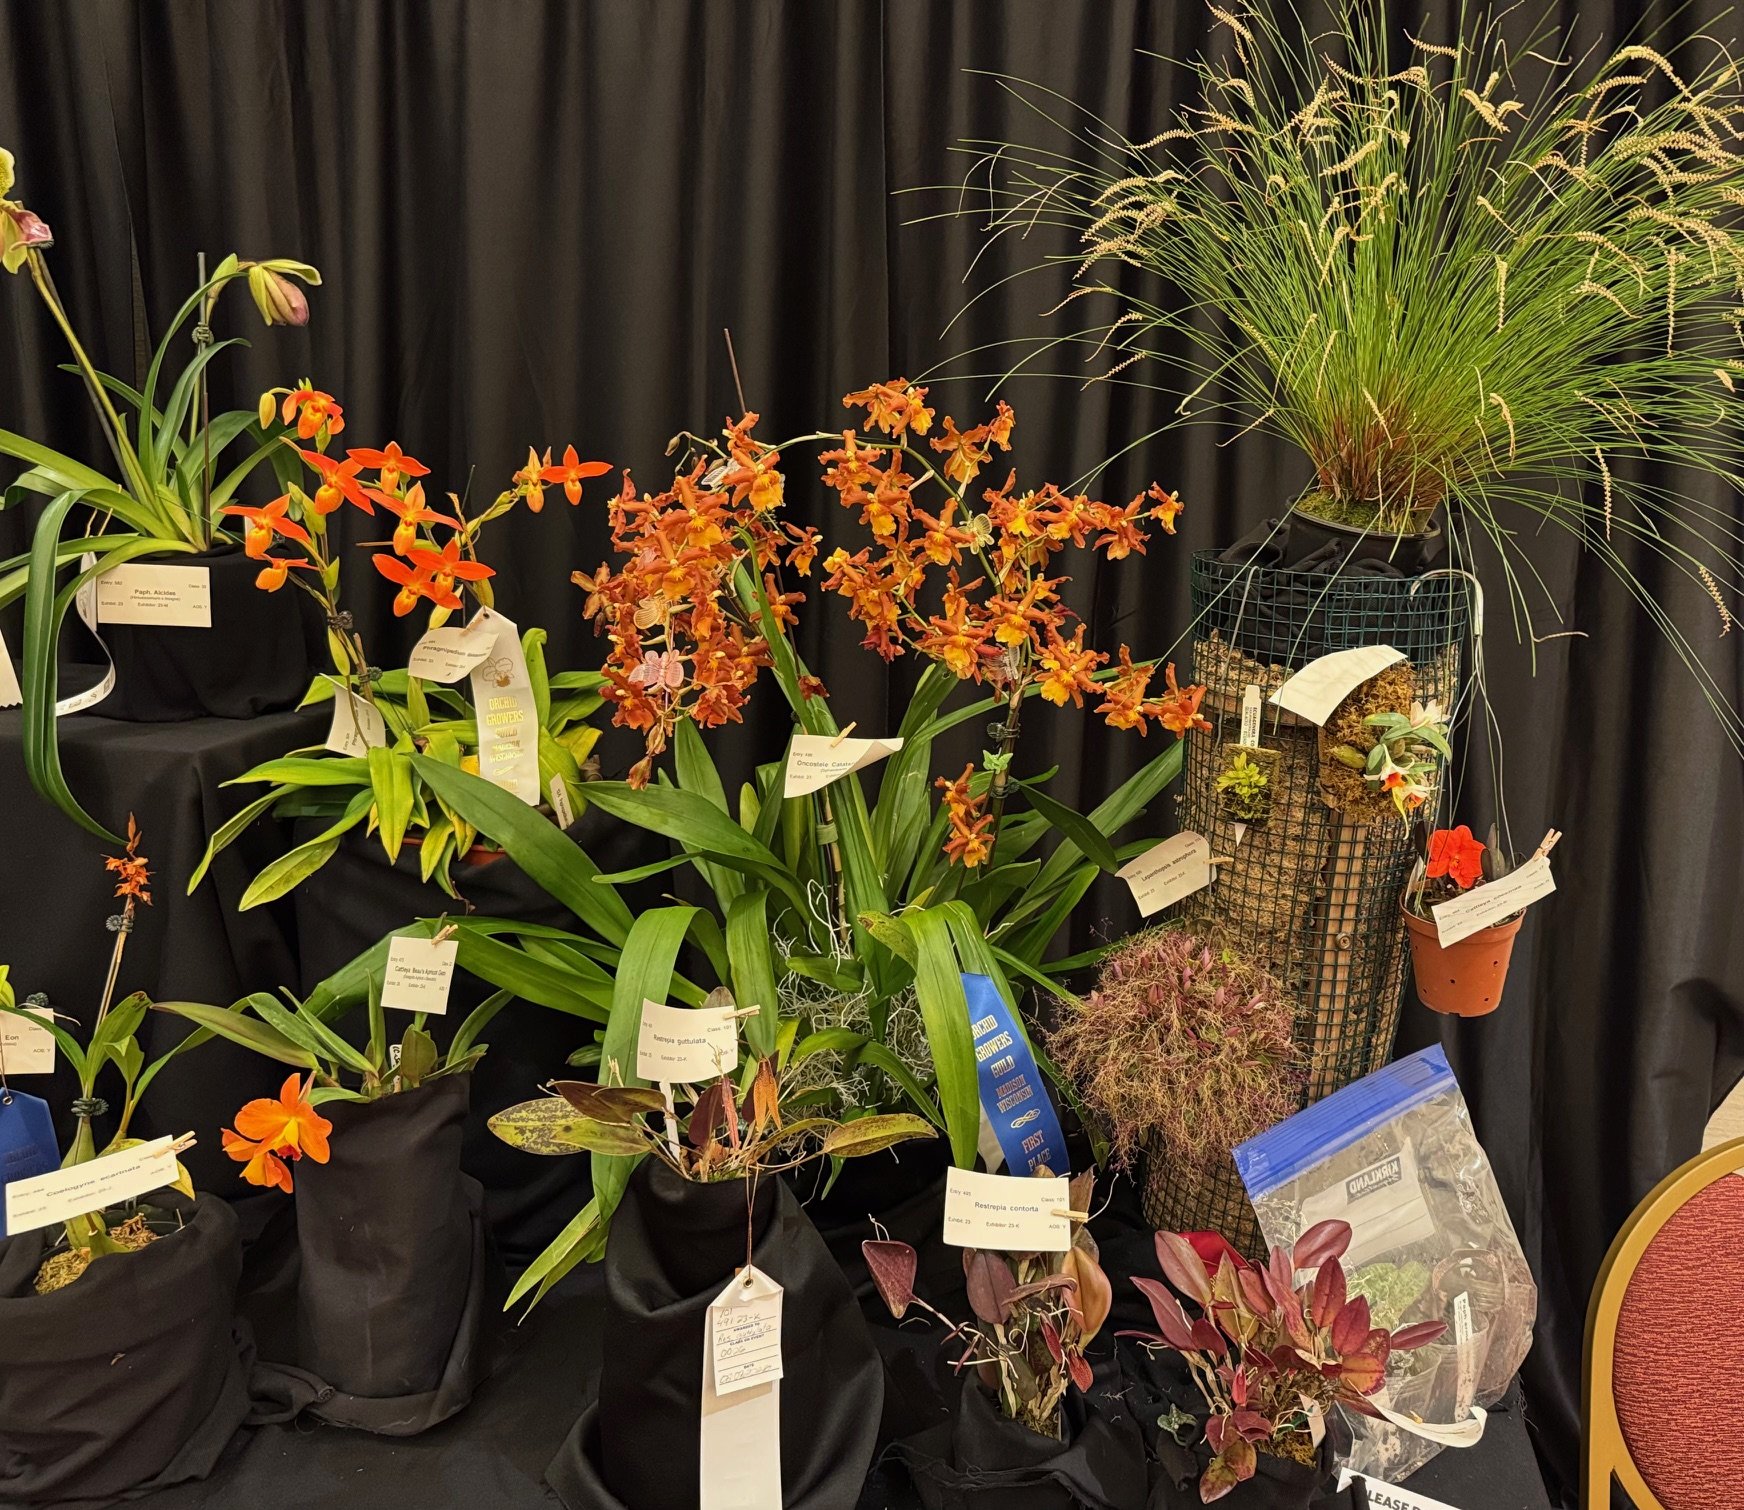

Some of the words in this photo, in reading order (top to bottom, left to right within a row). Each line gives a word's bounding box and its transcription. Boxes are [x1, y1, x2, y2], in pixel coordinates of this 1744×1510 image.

[489, 695, 518, 711] ORCHID
[486, 710, 525, 726] GROWERS
[1465, 899, 1491, 914] Cattleya
[677, 1038, 707, 1046] guttulata
[975, 1030, 1014, 1063] GROWERS
[990, 1054, 1015, 1079] GUILD
[996, 1073, 1026, 1099] MADISON
[996, 1084, 1034, 1114] WISCONSIN
[1021, 1129, 1045, 1154] FIRST
[1027, 1147, 1052, 1173] PLACE
[46, 1179, 96, 1197] Coelogyne
[99, 1165, 141, 1181] ecarinata
[974, 1201, 1007, 1212] Restrepia
[1009, 1205, 1039, 1213] contorta
[1367, 1489, 1410, 1510] LEASE
